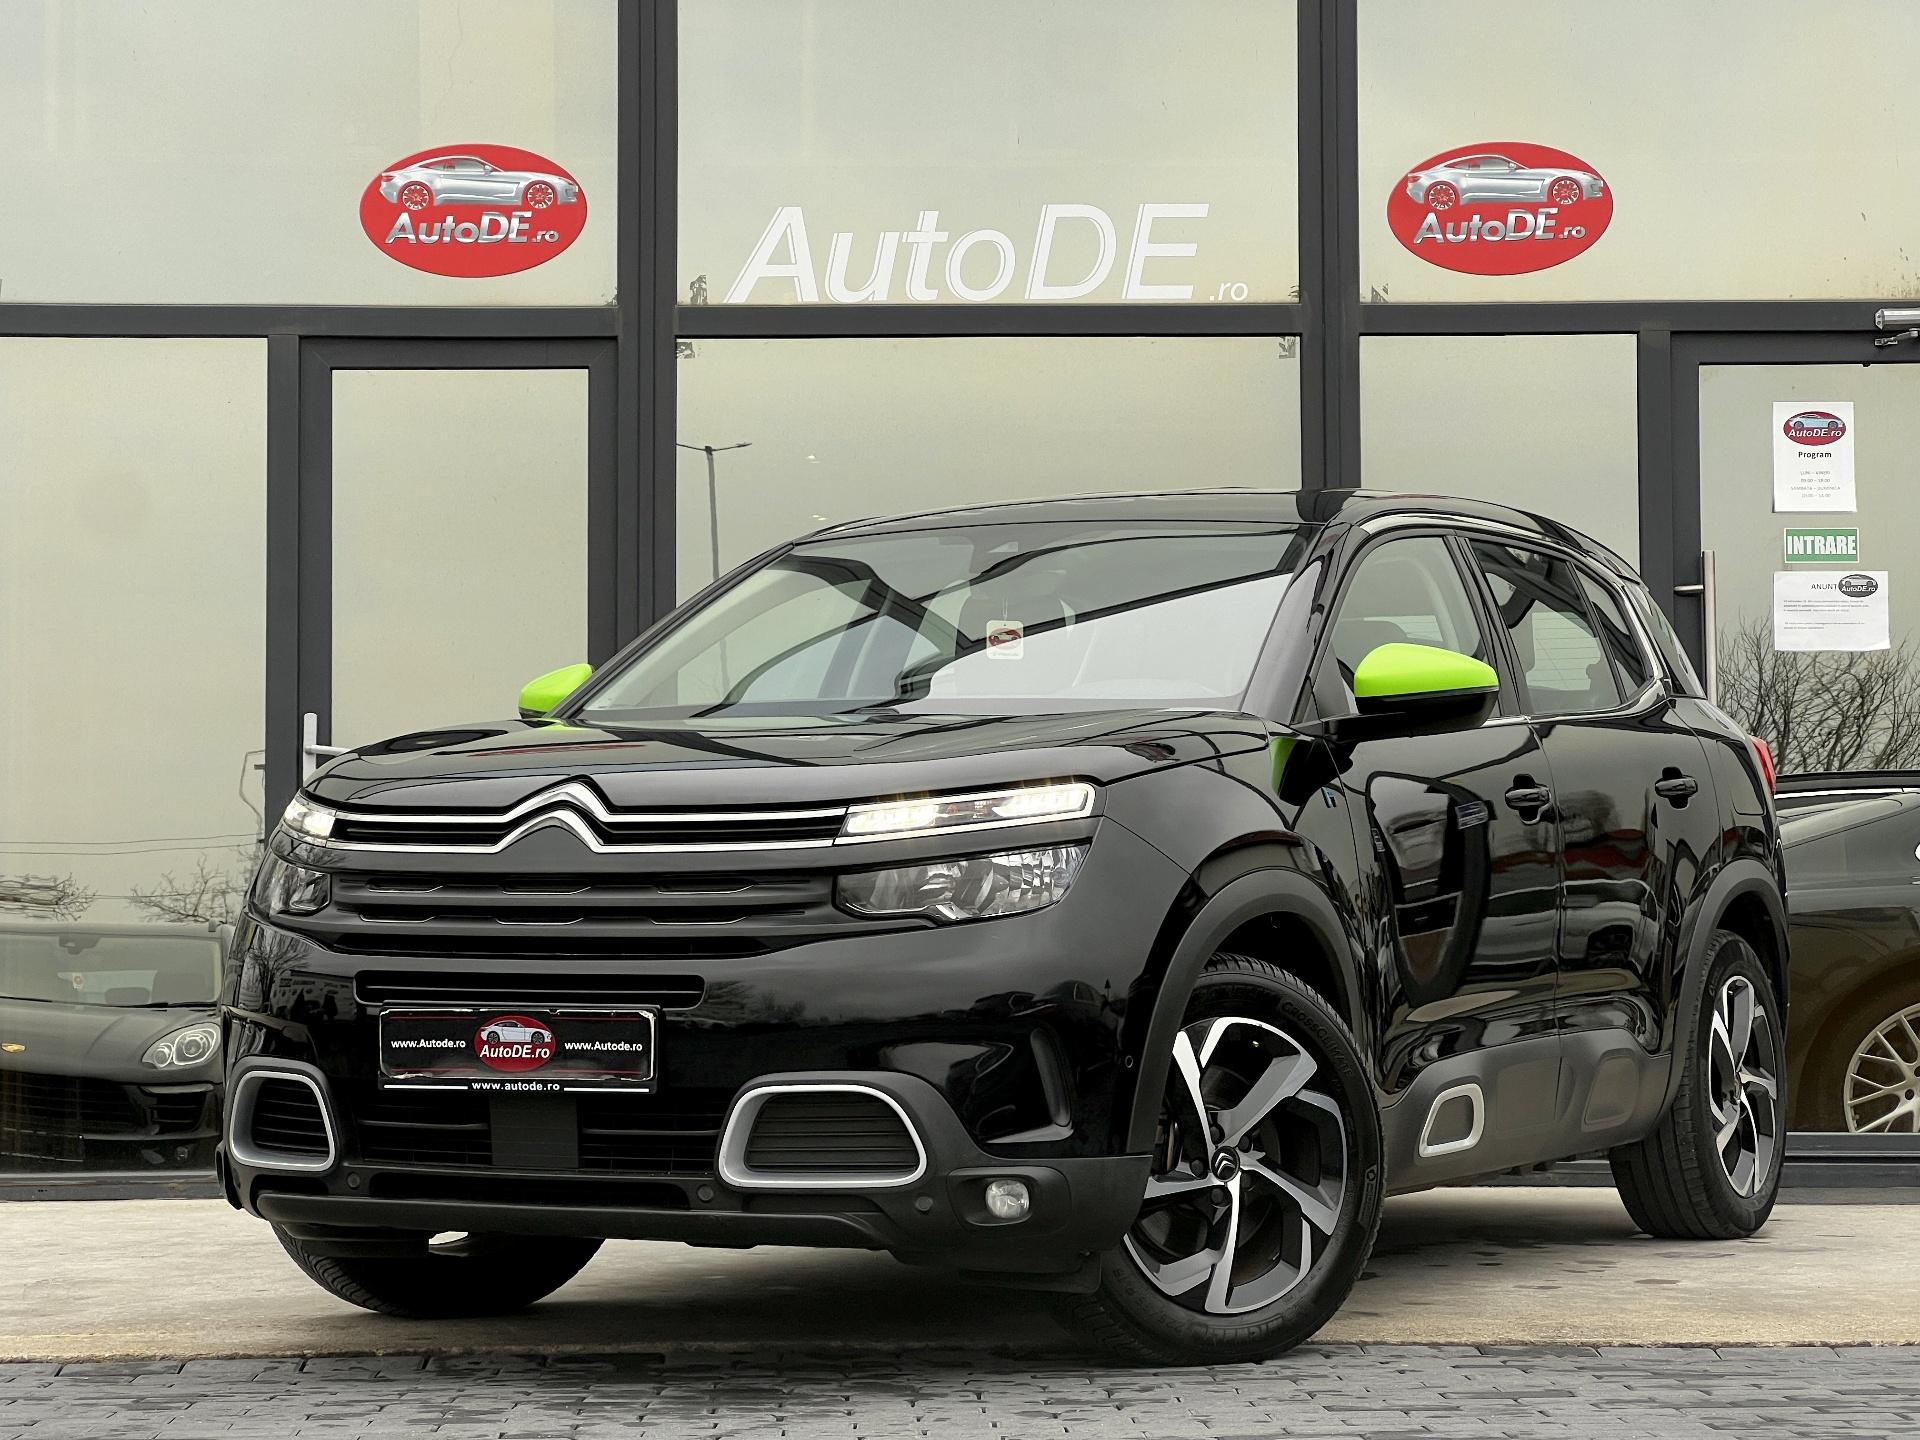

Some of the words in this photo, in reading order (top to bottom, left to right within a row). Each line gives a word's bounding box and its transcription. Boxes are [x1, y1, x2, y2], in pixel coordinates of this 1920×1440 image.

[1788, 428, 1842, 438] AutoDE.ro
[1798, 451, 1832, 460] Program
[1786, 535, 1857, 555] INTRARE
[1840, 585, 1876, 593] AutoDE.ro
[391, 1038, 466, 1049] www.Autode.ro
[564, 1040, 643, 1052] www.Autode.ro
[479, 1044, 550, 1060] AutoDE.ro
[472, 1081, 560, 1092] www.autode.ro
